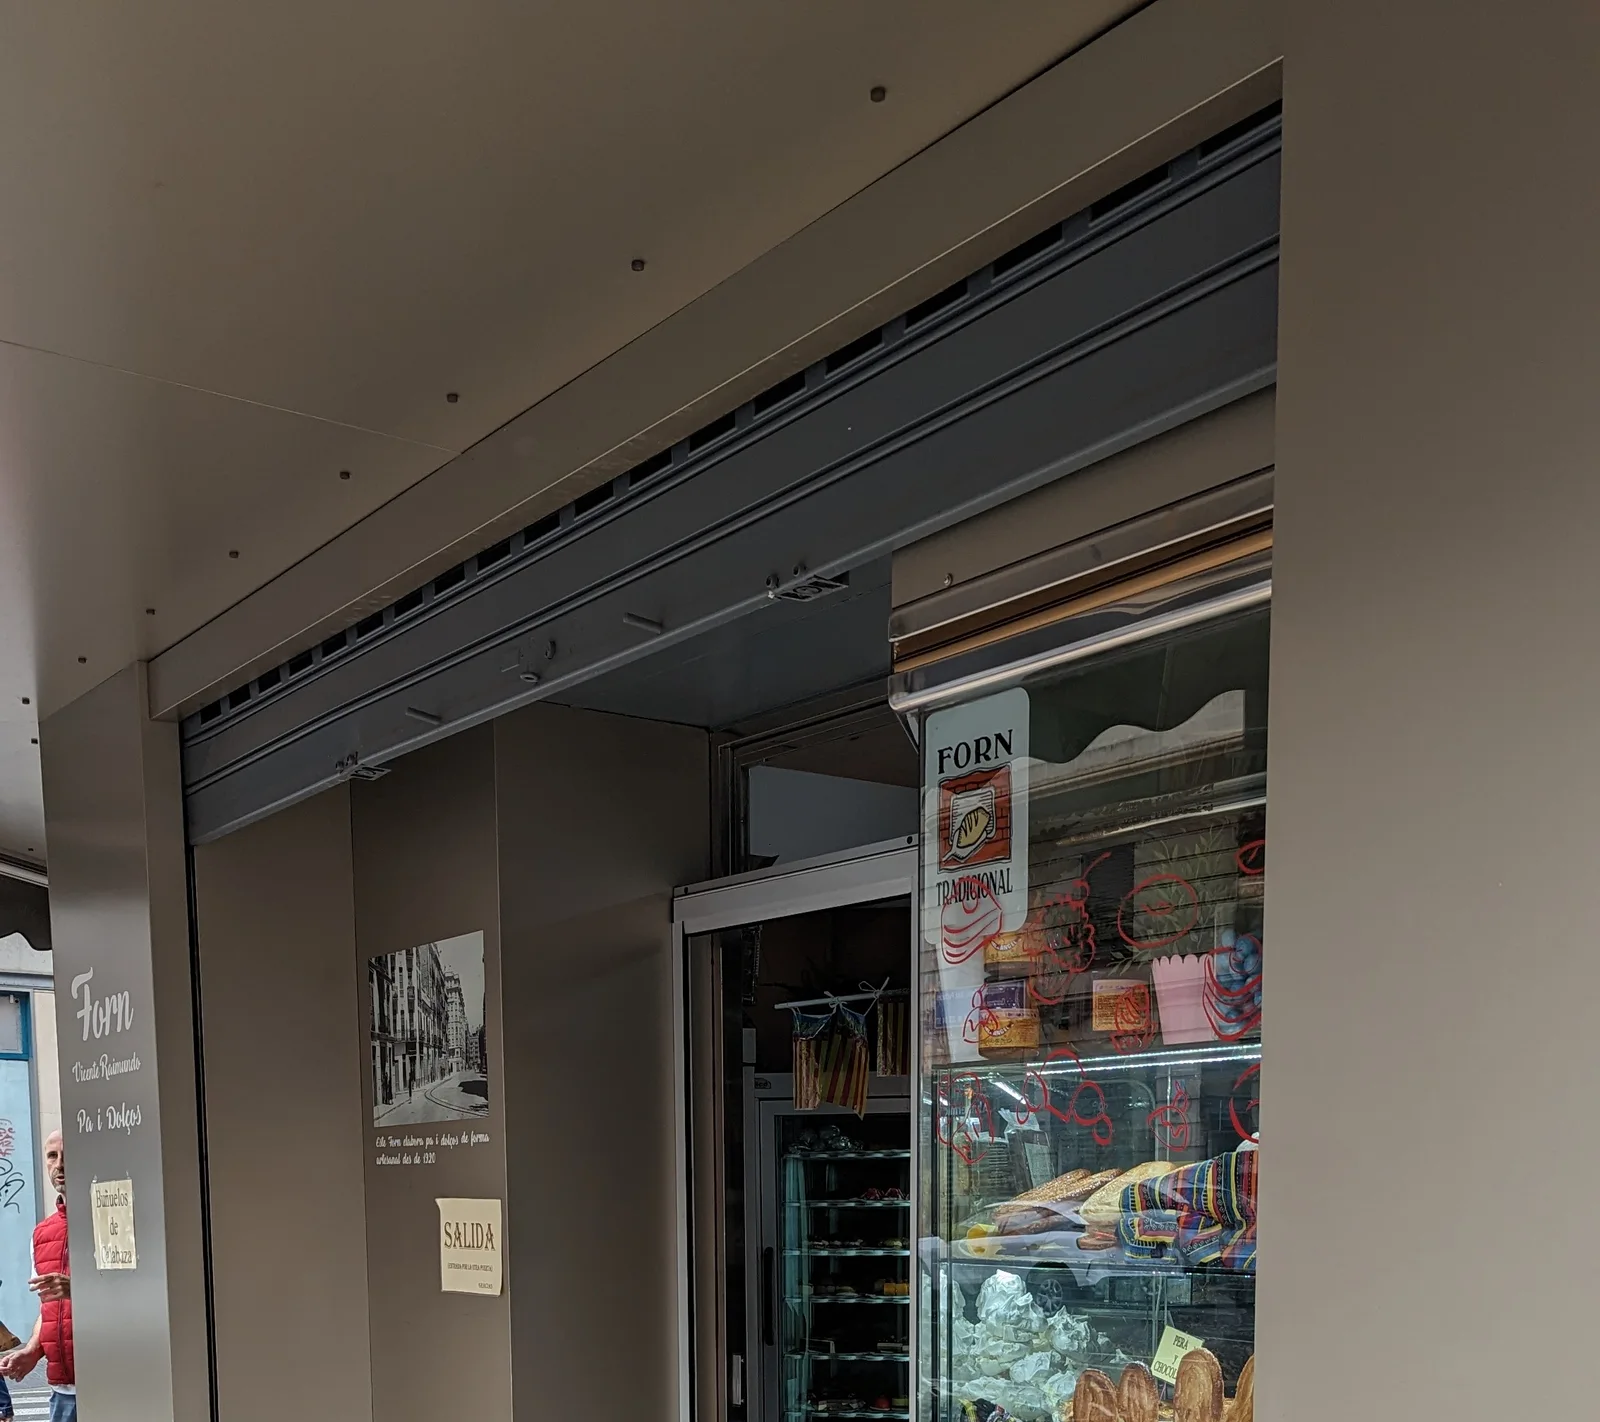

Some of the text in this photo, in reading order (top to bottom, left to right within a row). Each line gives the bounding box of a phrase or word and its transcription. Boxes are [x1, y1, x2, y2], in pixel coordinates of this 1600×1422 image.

[937, 729, 1013, 775] FORN
[936, 867, 1013, 907] TRADICIONAL
[71, 966, 134, 1041] Forn
[72, 1051, 141, 1082] Vicente Raimundo
[77, 1102, 142, 1135] Pa i Dolços
[402, 1134, 424, 1147] elabora
[425, 1137, 434, 1149] pa
[435, 1133, 439, 1145] i
[440, 1133, 459, 1149] dolços
[460, 1131, 469, 1144] de
[470, 1130, 490, 1147] forma
[376, 1153, 401, 1165] artesanal
[402, 1153, 412, 1165] des
[413, 1152, 421, 1164] de
[95, 1188, 129, 1208] Buñuelos
[109, 1216, 118, 1236] de
[443, 1221, 496, 1251] SALIDA
[1172, 1334, 1189, 1350] PERA
[1153, 1360, 1178, 1380] CHOCOL
